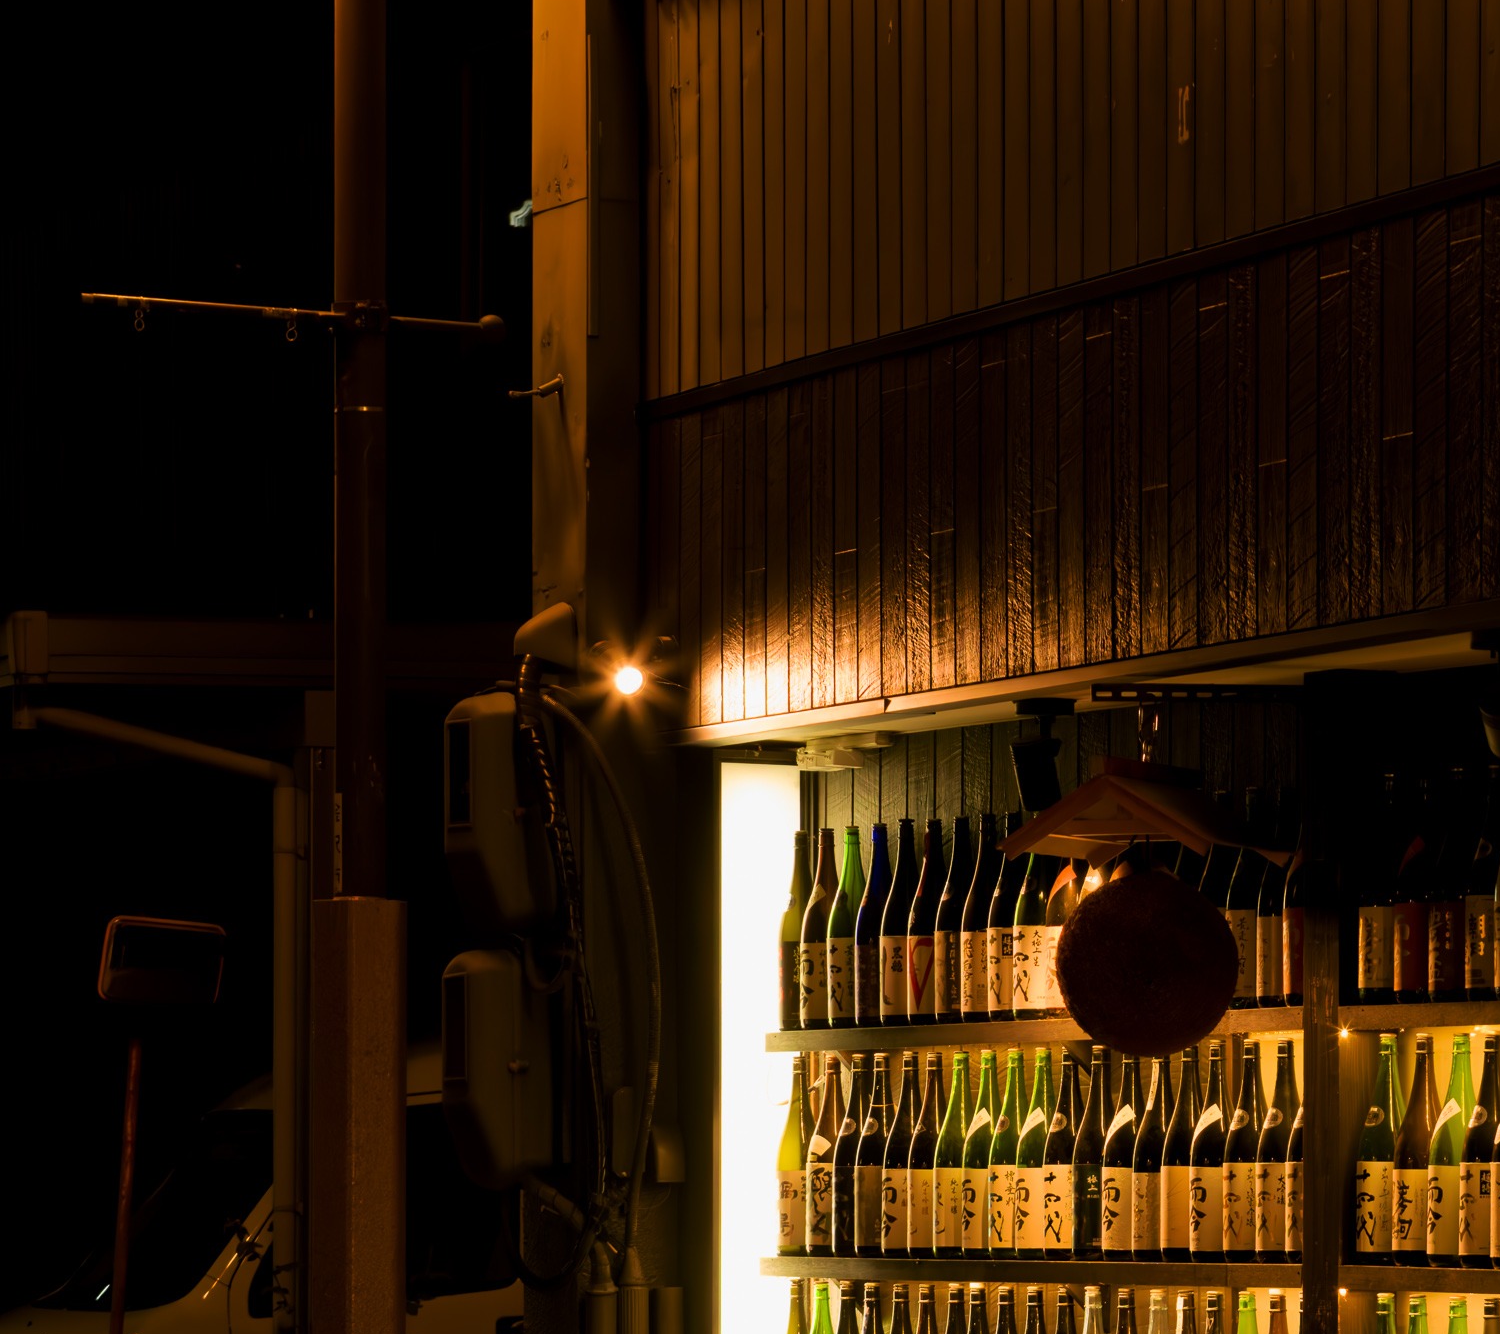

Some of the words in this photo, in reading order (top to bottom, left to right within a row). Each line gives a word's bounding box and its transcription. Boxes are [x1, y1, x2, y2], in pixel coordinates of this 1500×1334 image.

[1044, 1171, 1063, 1243] 十四代
[1103, 1177, 1120, 1232] 而今
[1189, 1177, 1207, 1232] 而今
[1355, 1169, 1376, 1246] 十四代
[1427, 1177, 1443, 1234] 而今
